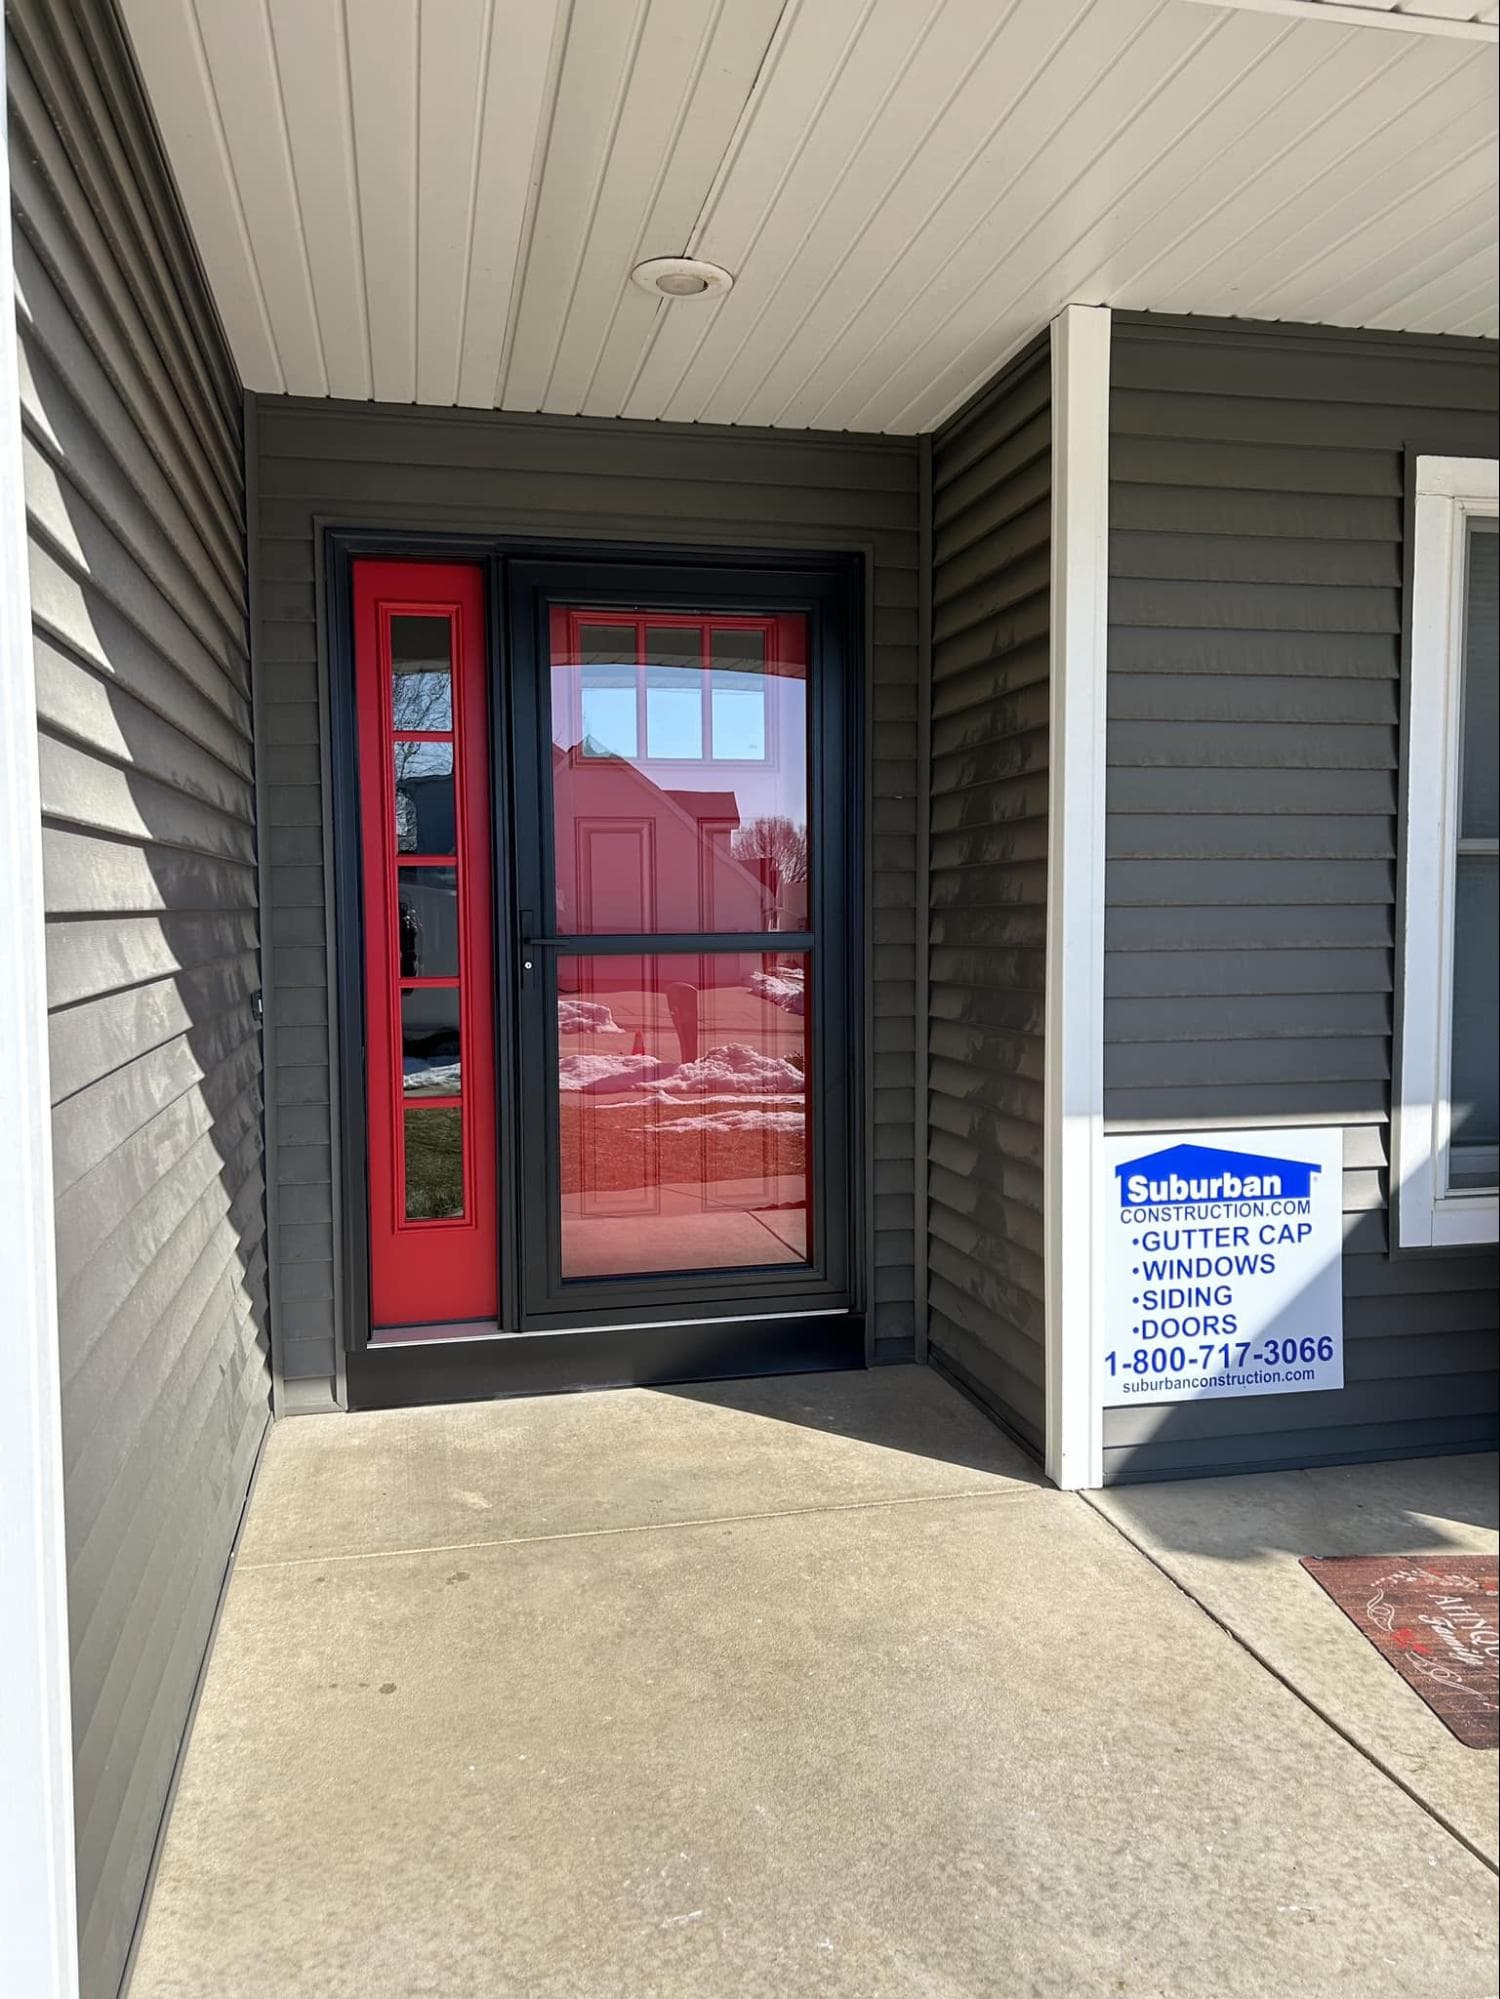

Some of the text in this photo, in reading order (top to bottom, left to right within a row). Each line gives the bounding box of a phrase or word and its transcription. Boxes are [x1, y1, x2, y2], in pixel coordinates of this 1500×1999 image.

[1127, 1172, 1282, 1204] Suburban
[1120, 1200, 1311, 1224] CONSTRUCTION.COM
[1142, 1223, 1313, 1251] GUTTER CAP
[1142, 1254, 1276, 1281] WINDOWS
[1142, 1285, 1233, 1311] SIDING
[1141, 1314, 1238, 1340] DOORS
[1104, 1336, 1334, 1377] 1-800-717-3066
[1122, 1367, 1315, 1393] suburbanconstruction.com
